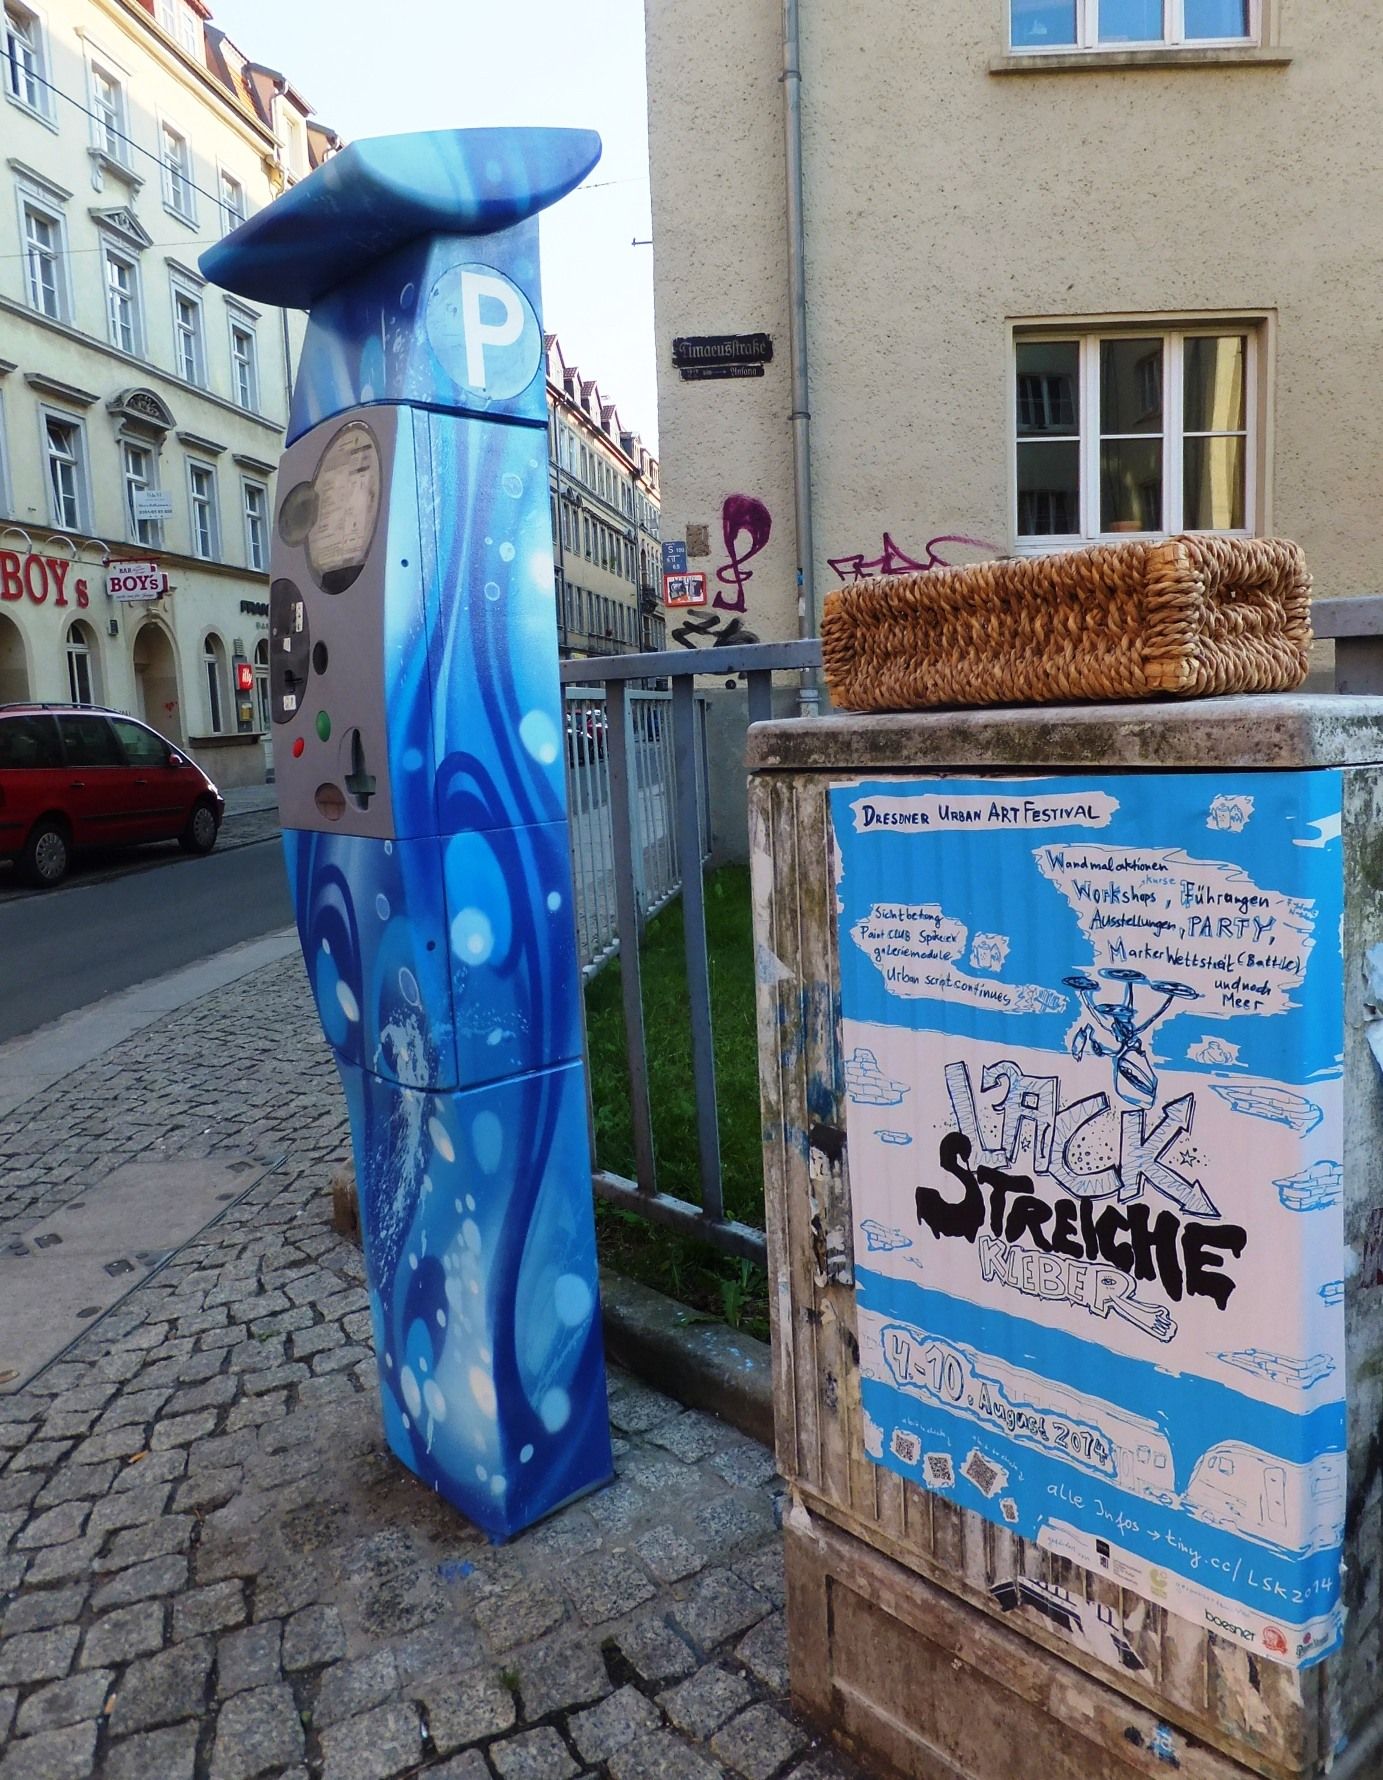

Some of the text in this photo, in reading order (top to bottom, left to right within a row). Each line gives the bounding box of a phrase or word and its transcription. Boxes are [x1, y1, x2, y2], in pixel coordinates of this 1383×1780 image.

[461, 271, 525, 389] P
[862, 800, 1101, 827] DRESDNER URBAN ART FESTIVAL
[915, 1131, 1249, 1311] STREICHE
[978, 1235, 1179, 1344] KLEBER
[978, 1383, 1050, 1443] August
[1052, 1420, 1112, 1467] 2014
[1046, 1484, 1085, 1509] alle
[1094, 1500, 1141, 1537] Infos
